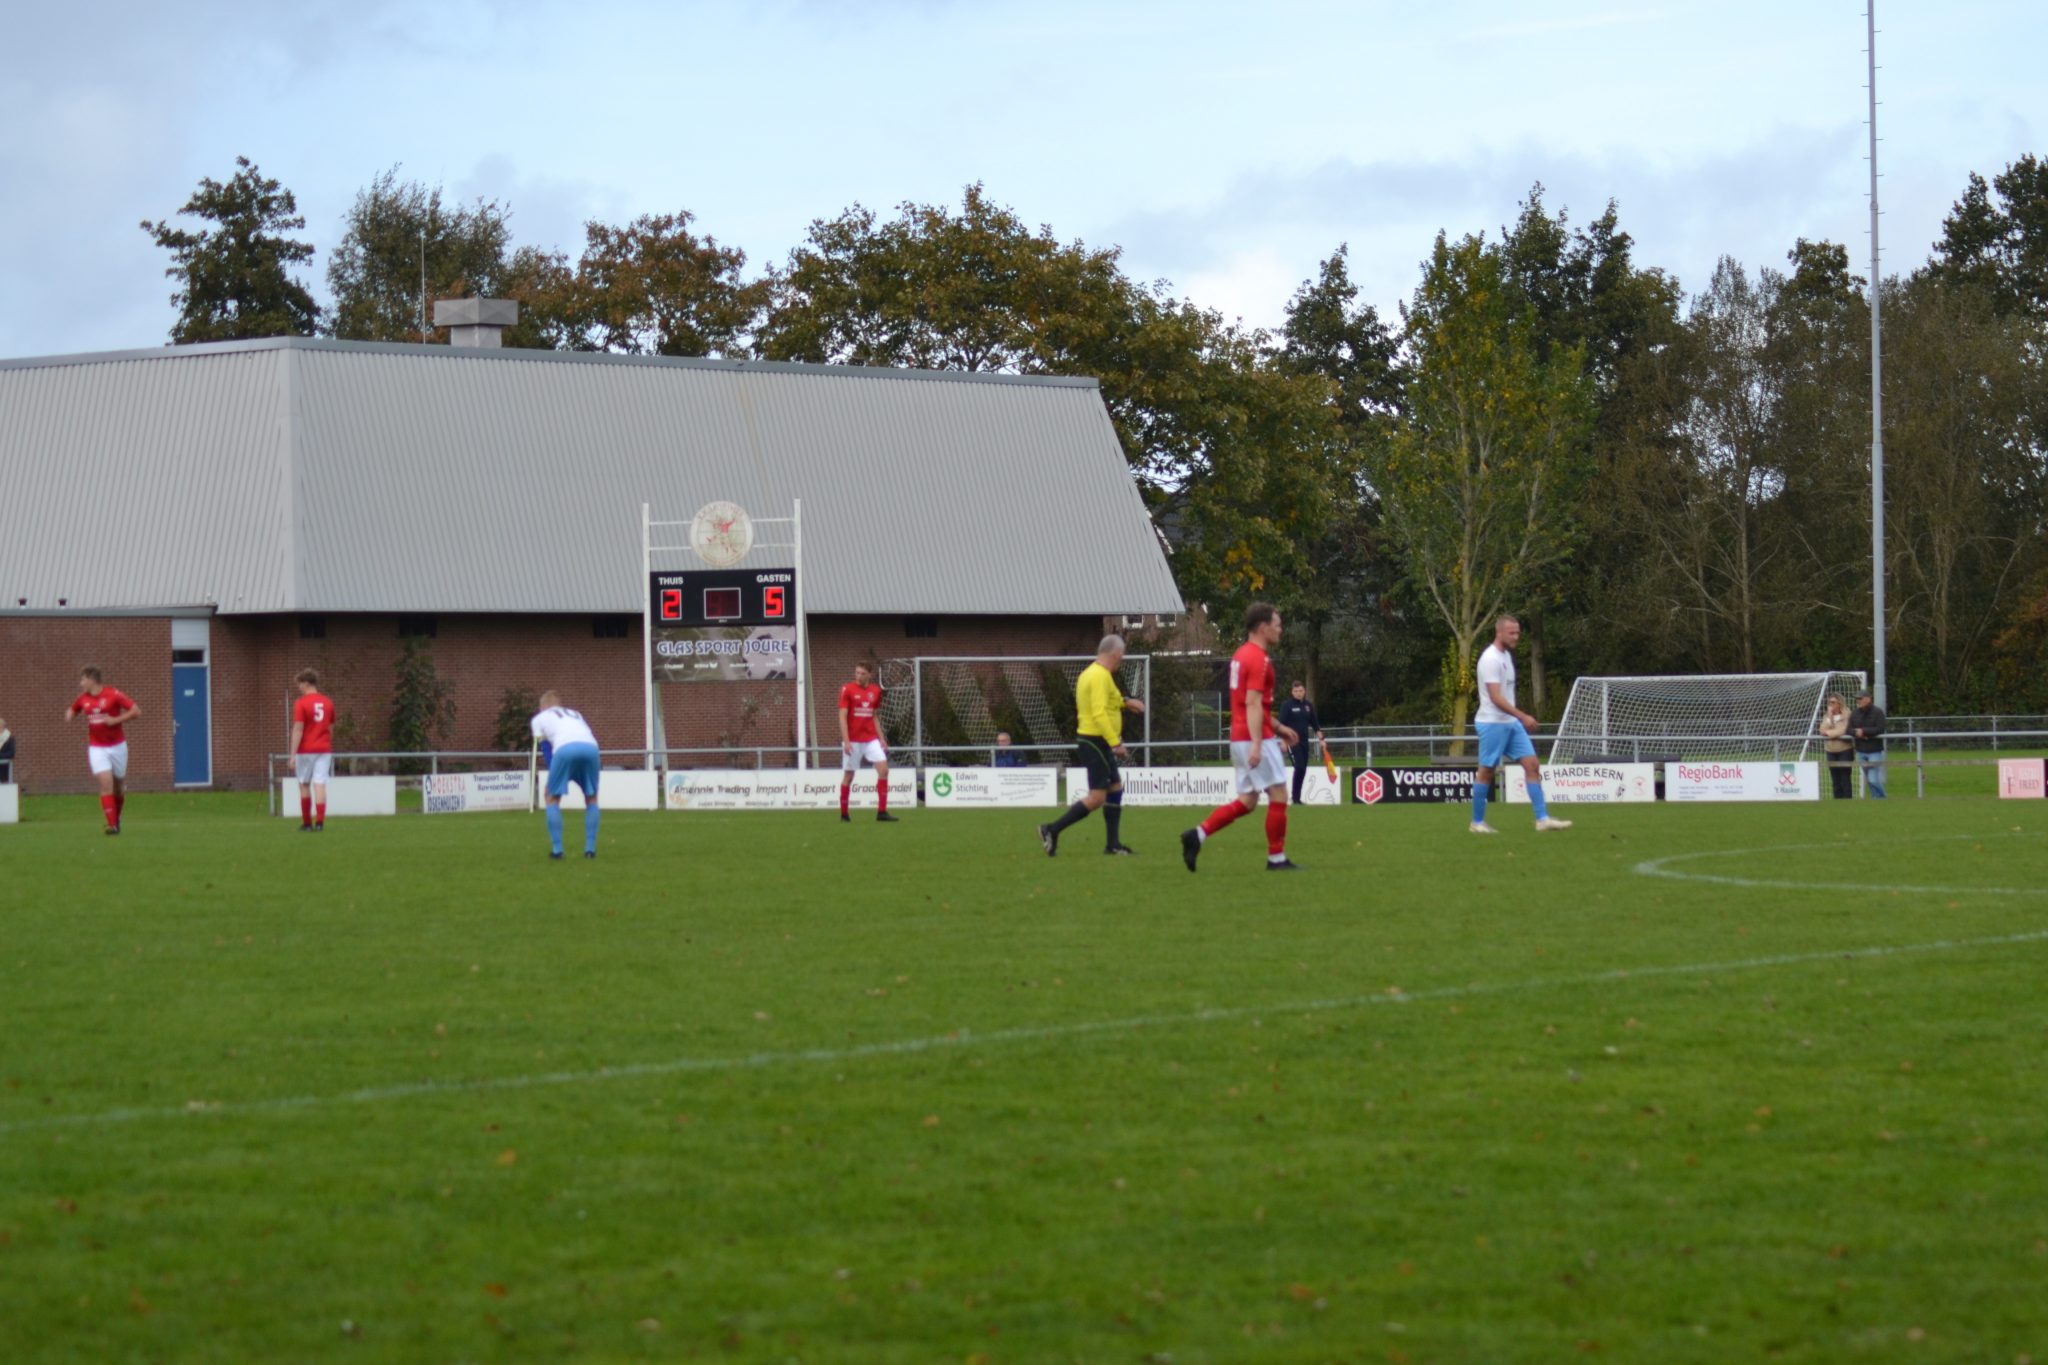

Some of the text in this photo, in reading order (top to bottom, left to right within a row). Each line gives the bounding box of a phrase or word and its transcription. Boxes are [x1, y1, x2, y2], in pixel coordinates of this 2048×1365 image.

[658, 577, 683, 585] THUIS
[756, 574, 791, 583] GASTEN
[662, 590, 680, 618] 2
[765, 588, 782, 616] 5
[657, 639, 790, 656] GLAS SPORT JOURE
[314, 702, 325, 722] 5
[504, 773, 524, 782] Opslag
[955, 772, 978, 781] Edwin
[1392, 770, 1478, 785] VOEGBEDRI
[1553, 767, 1590, 778] HARDE
[1593, 767, 1624, 781] KERN
[1678, 764, 1743, 783] RegioBank
[718, 785, 750, 797] Trading
[756, 784, 788, 796] Import
[803, 784, 836, 795] Export
[851, 782, 912, 793] Groondel
[955, 784, 989, 794] Stichting
[1123, 771, 1229, 795] dministratiekantoor
[1567, 779, 1604, 788] Langweer
[1396, 787, 1474, 797] LANGWE
[1576, 793, 1609, 801] SUCCES!
